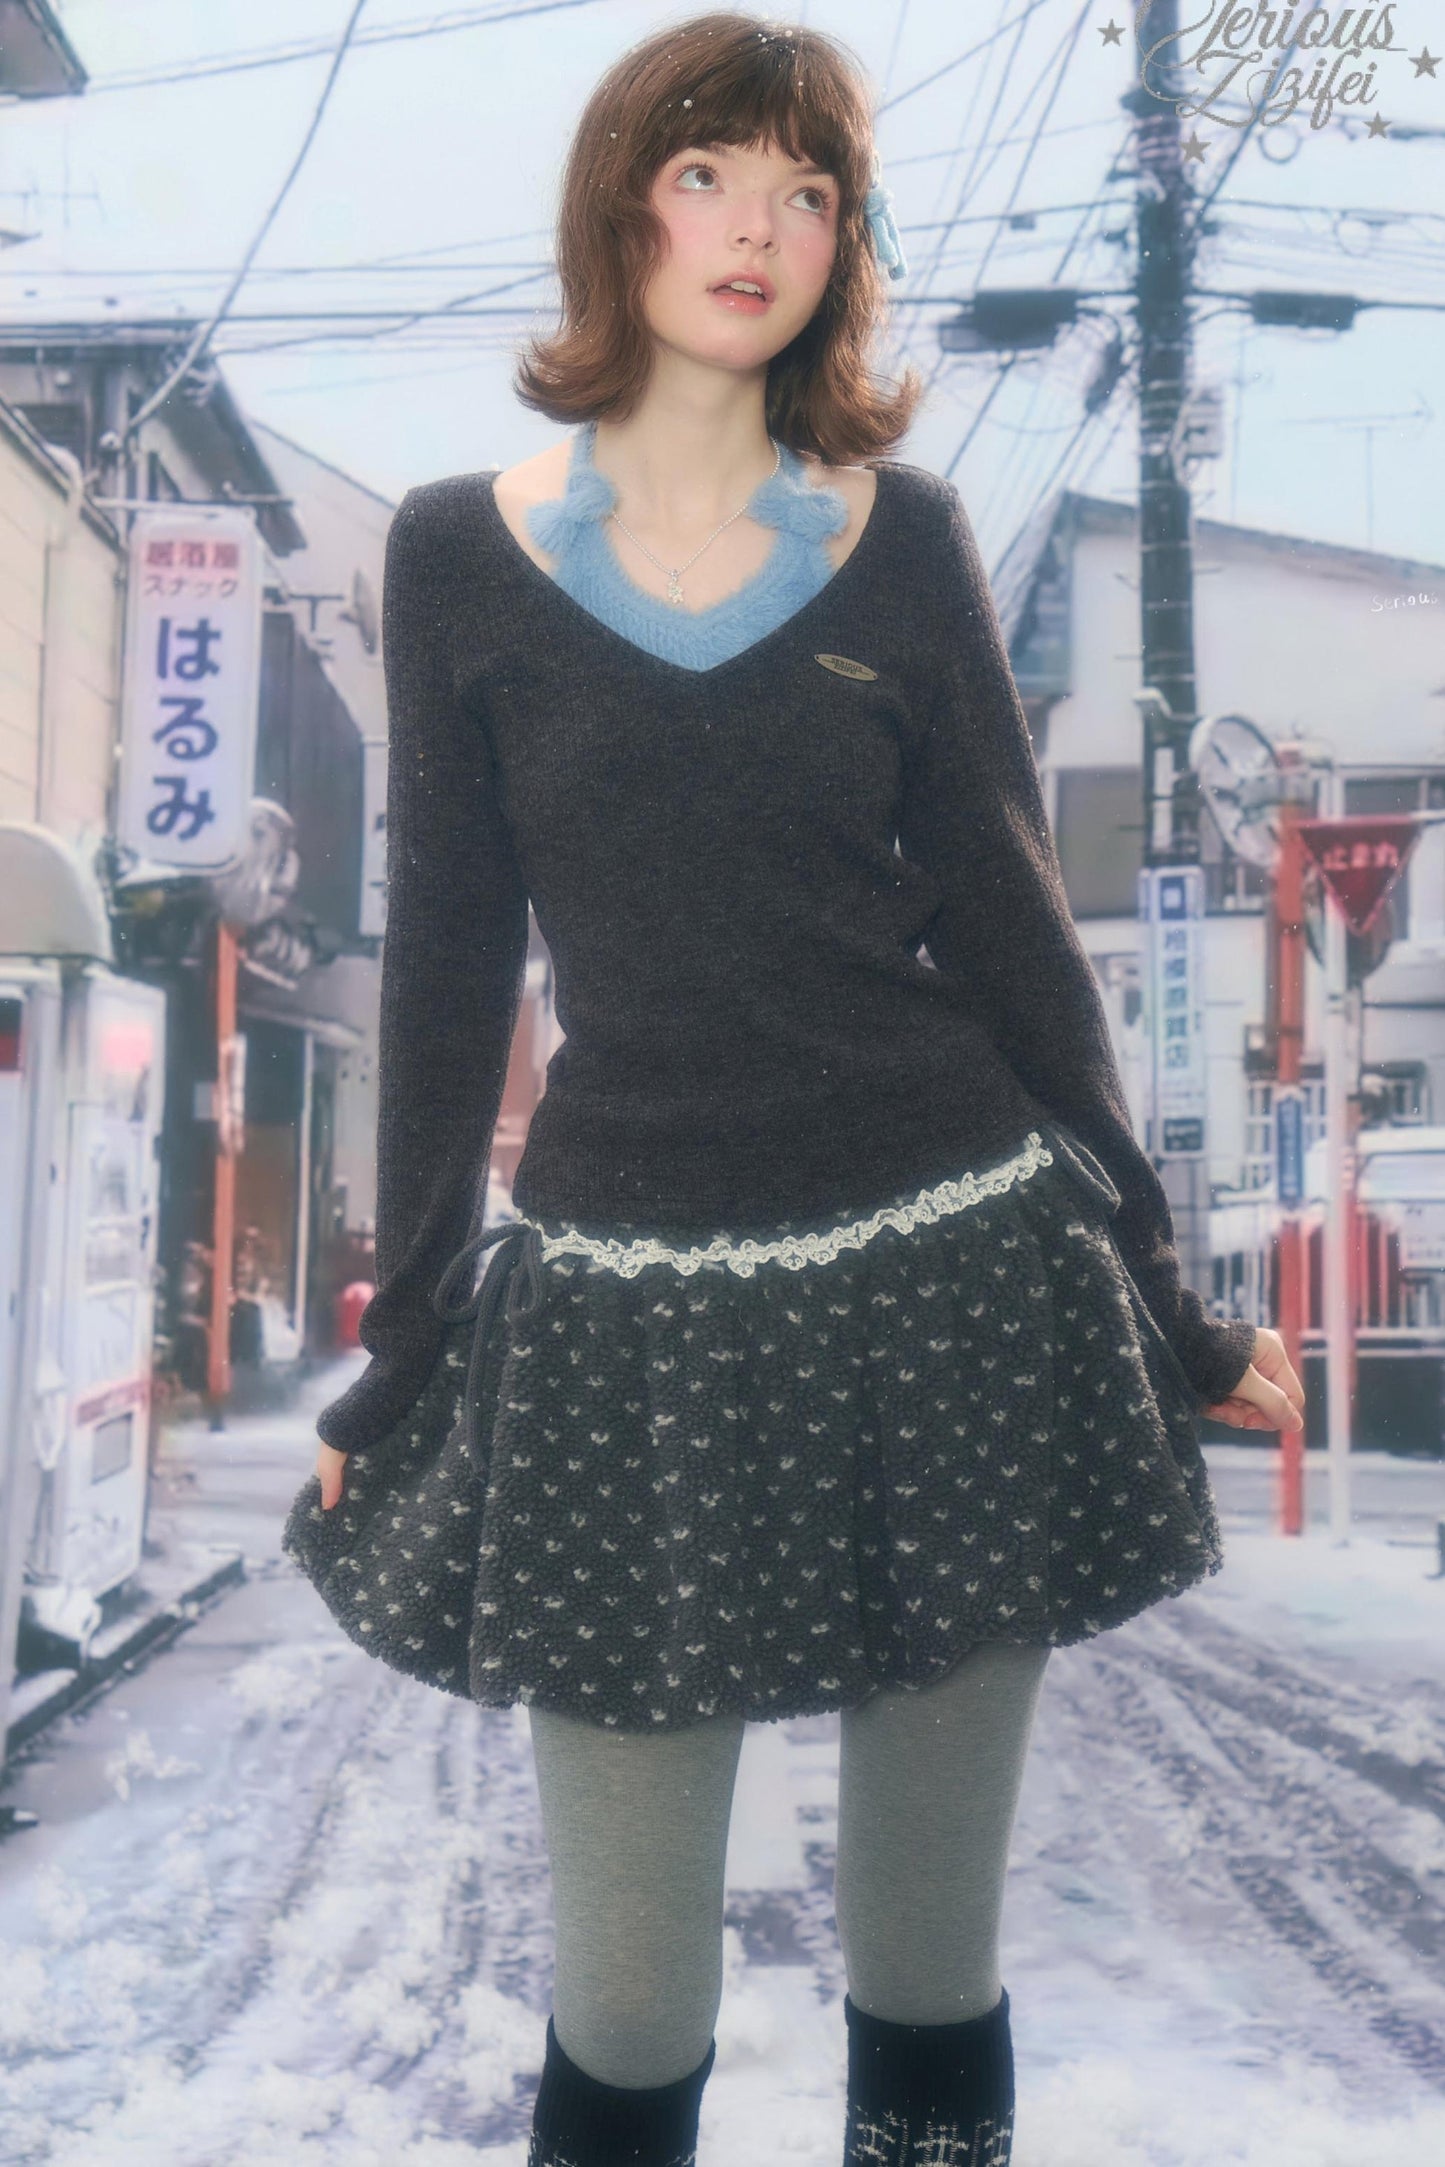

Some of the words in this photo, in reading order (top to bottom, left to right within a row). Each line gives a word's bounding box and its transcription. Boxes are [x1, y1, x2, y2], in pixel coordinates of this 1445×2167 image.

[144, 575, 238, 599] スナック
[147, 617, 222, 842] はるみ
